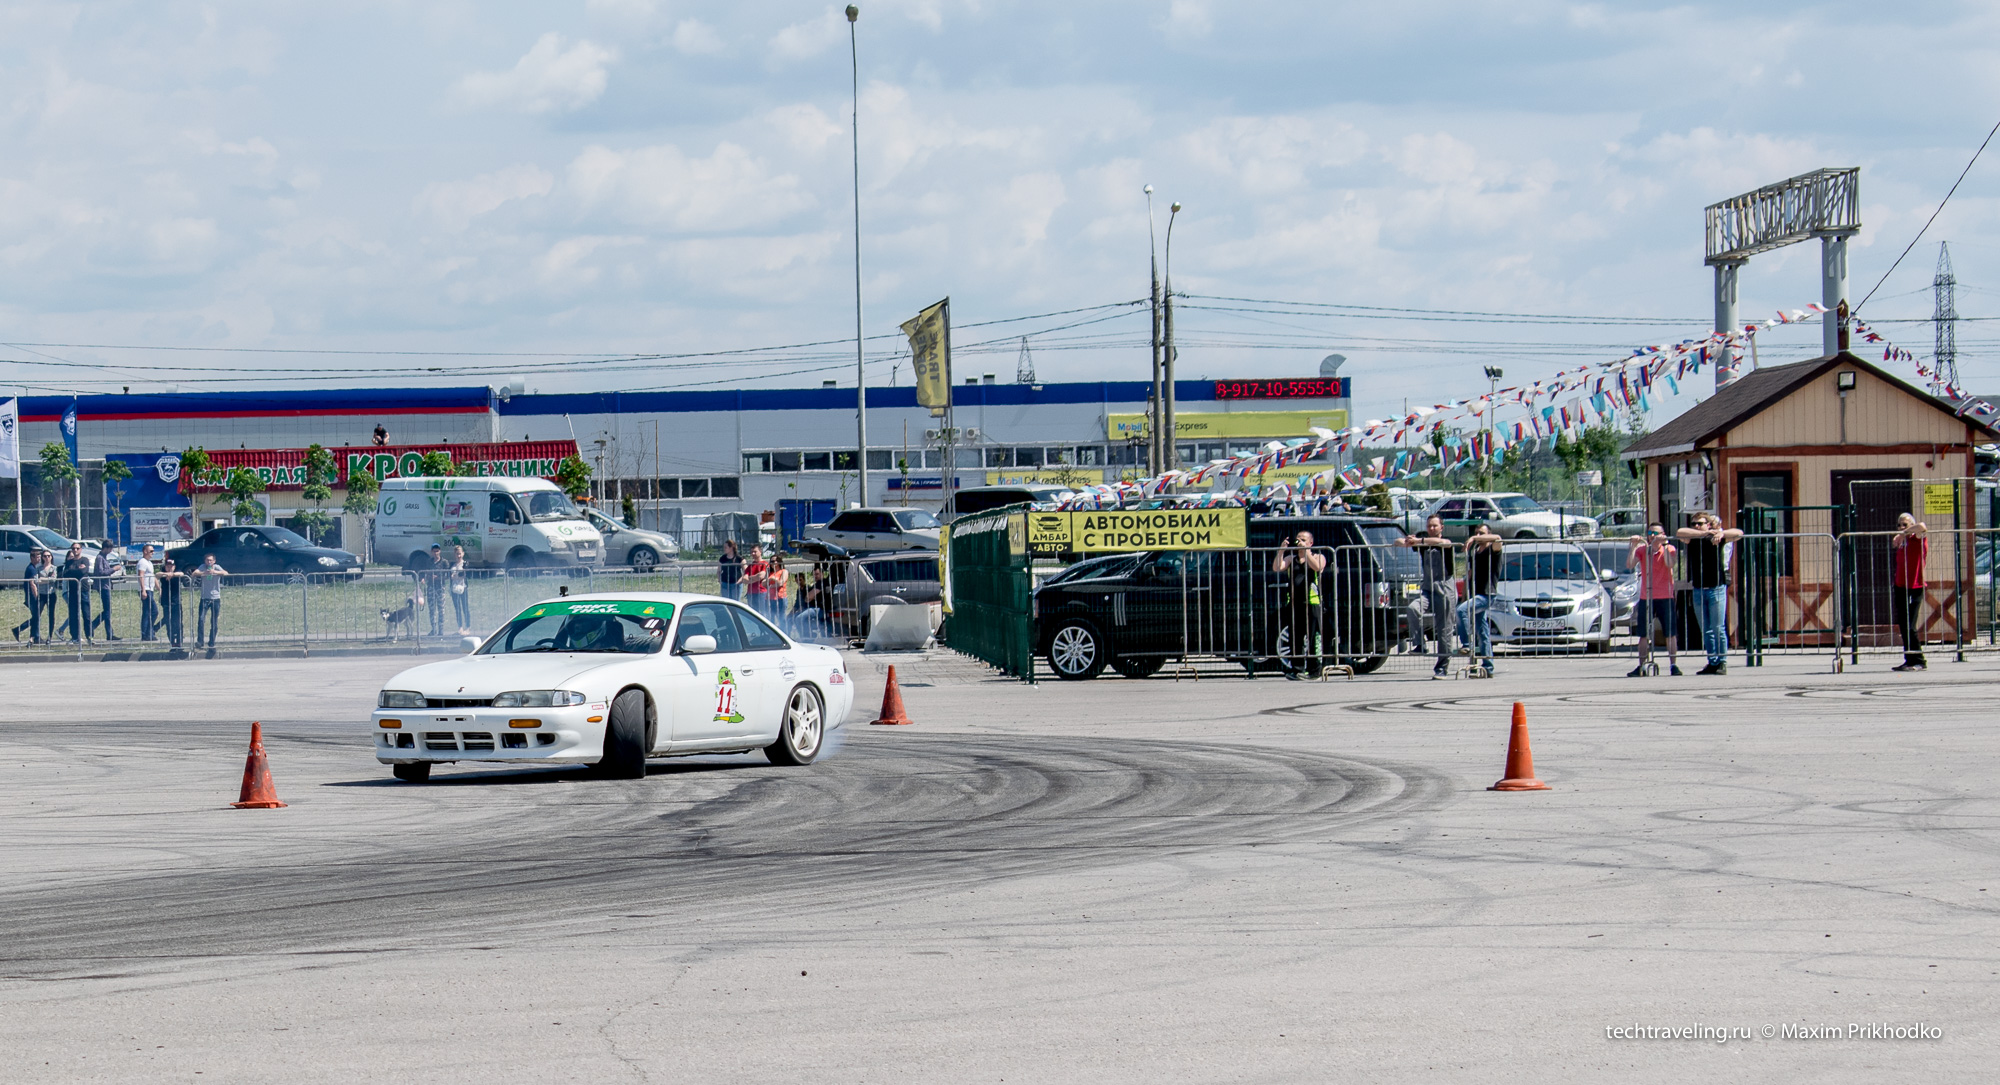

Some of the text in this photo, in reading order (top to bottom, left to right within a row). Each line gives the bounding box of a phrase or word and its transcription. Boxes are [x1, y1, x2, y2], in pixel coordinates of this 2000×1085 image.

[1217, 380, 1340, 398] 8-917-10-5555-0
[1117, 422, 1142, 431] Mobil
[1175, 421, 1208, 432] Express
[997, 476, 1023, 485] Mobil
[1083, 513, 1221, 530] АВТОМОБИЛИ
[1032, 533, 1068, 541] АМБАР
[1083, 530, 1211, 547] С ПРОБЕГОМ
[716, 686, 732, 714] 11
